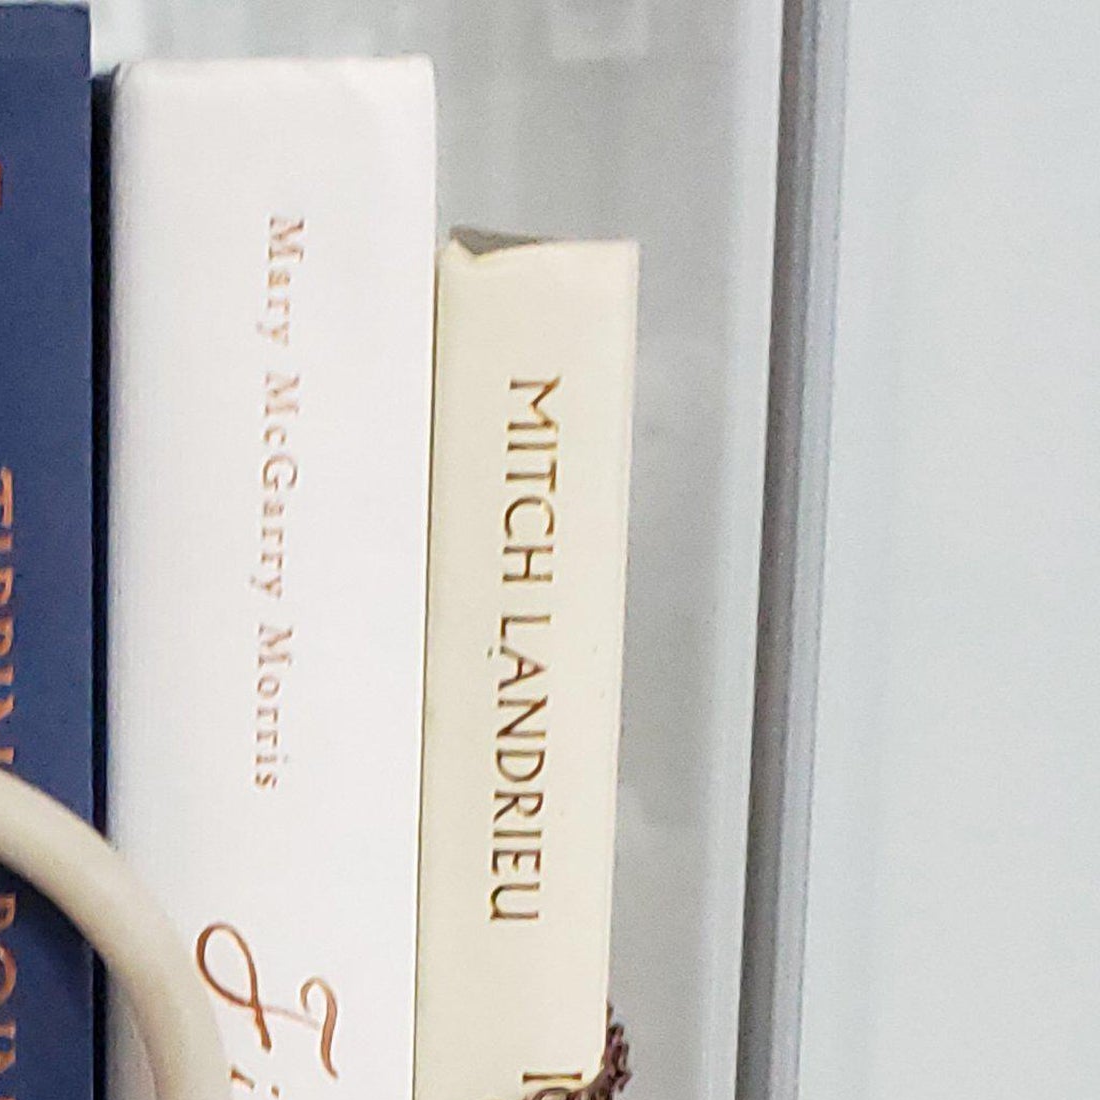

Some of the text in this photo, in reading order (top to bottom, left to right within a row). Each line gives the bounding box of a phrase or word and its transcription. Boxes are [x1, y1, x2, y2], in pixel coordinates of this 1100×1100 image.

[250, 217, 304, 788] Mary McGarry Morris
[488, 374, 561, 922] MITCH LANDRIEU
